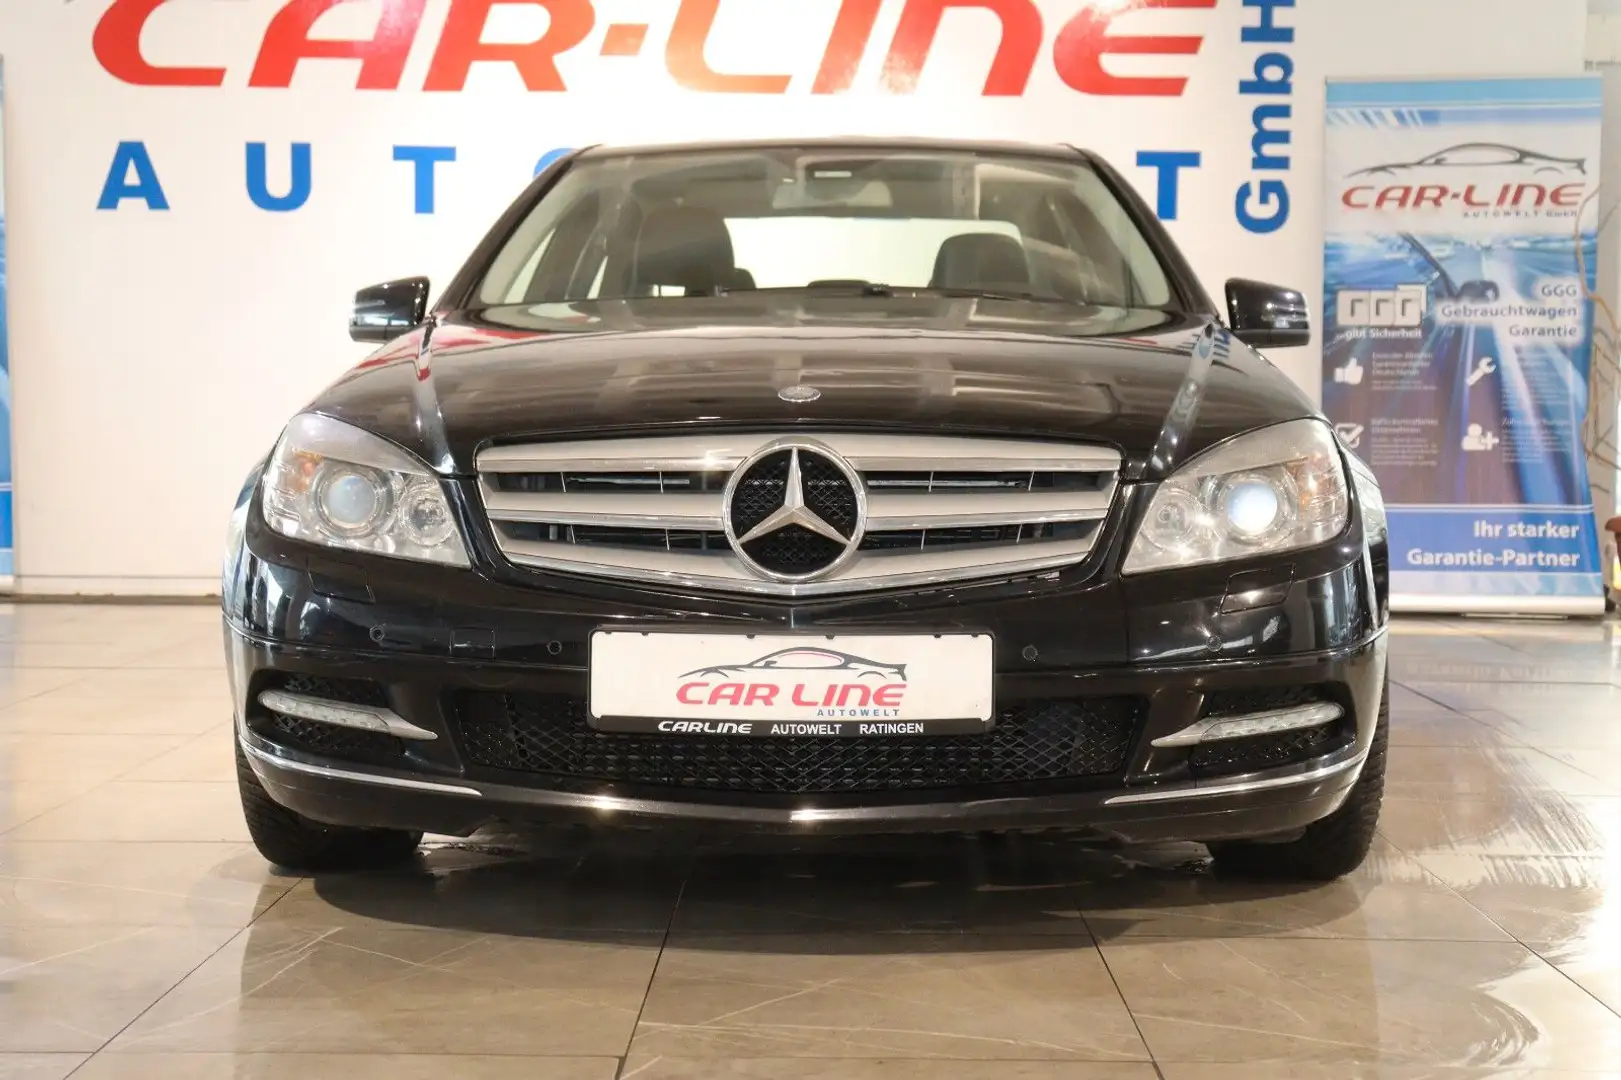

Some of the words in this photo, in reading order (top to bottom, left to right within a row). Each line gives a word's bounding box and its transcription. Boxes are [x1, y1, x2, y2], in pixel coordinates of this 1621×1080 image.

[1235, 0, 1295, 233] GmbH
[1341, 182, 1586, 209] CAR-LINE
[1540, 284, 1577, 298] GGG
[1441, 304, 1577, 321] Gebrauchtwagen
[1508, 324, 1577, 338] Garantie
[1473, 520, 1502, 538] Ihr
[1507, 520, 1580, 539] starker
[1406, 548, 1580, 567] Garantie-Partner
[676, 681, 779, 706] CAR
[791, 683, 907, 707] LINE
[817, 708, 900, 717] AUTOWELT
[657, 720, 752, 734] CARLINE
[770, 723, 842, 735] AUTOWELT
[859, 722, 924, 735] RATINGEN
